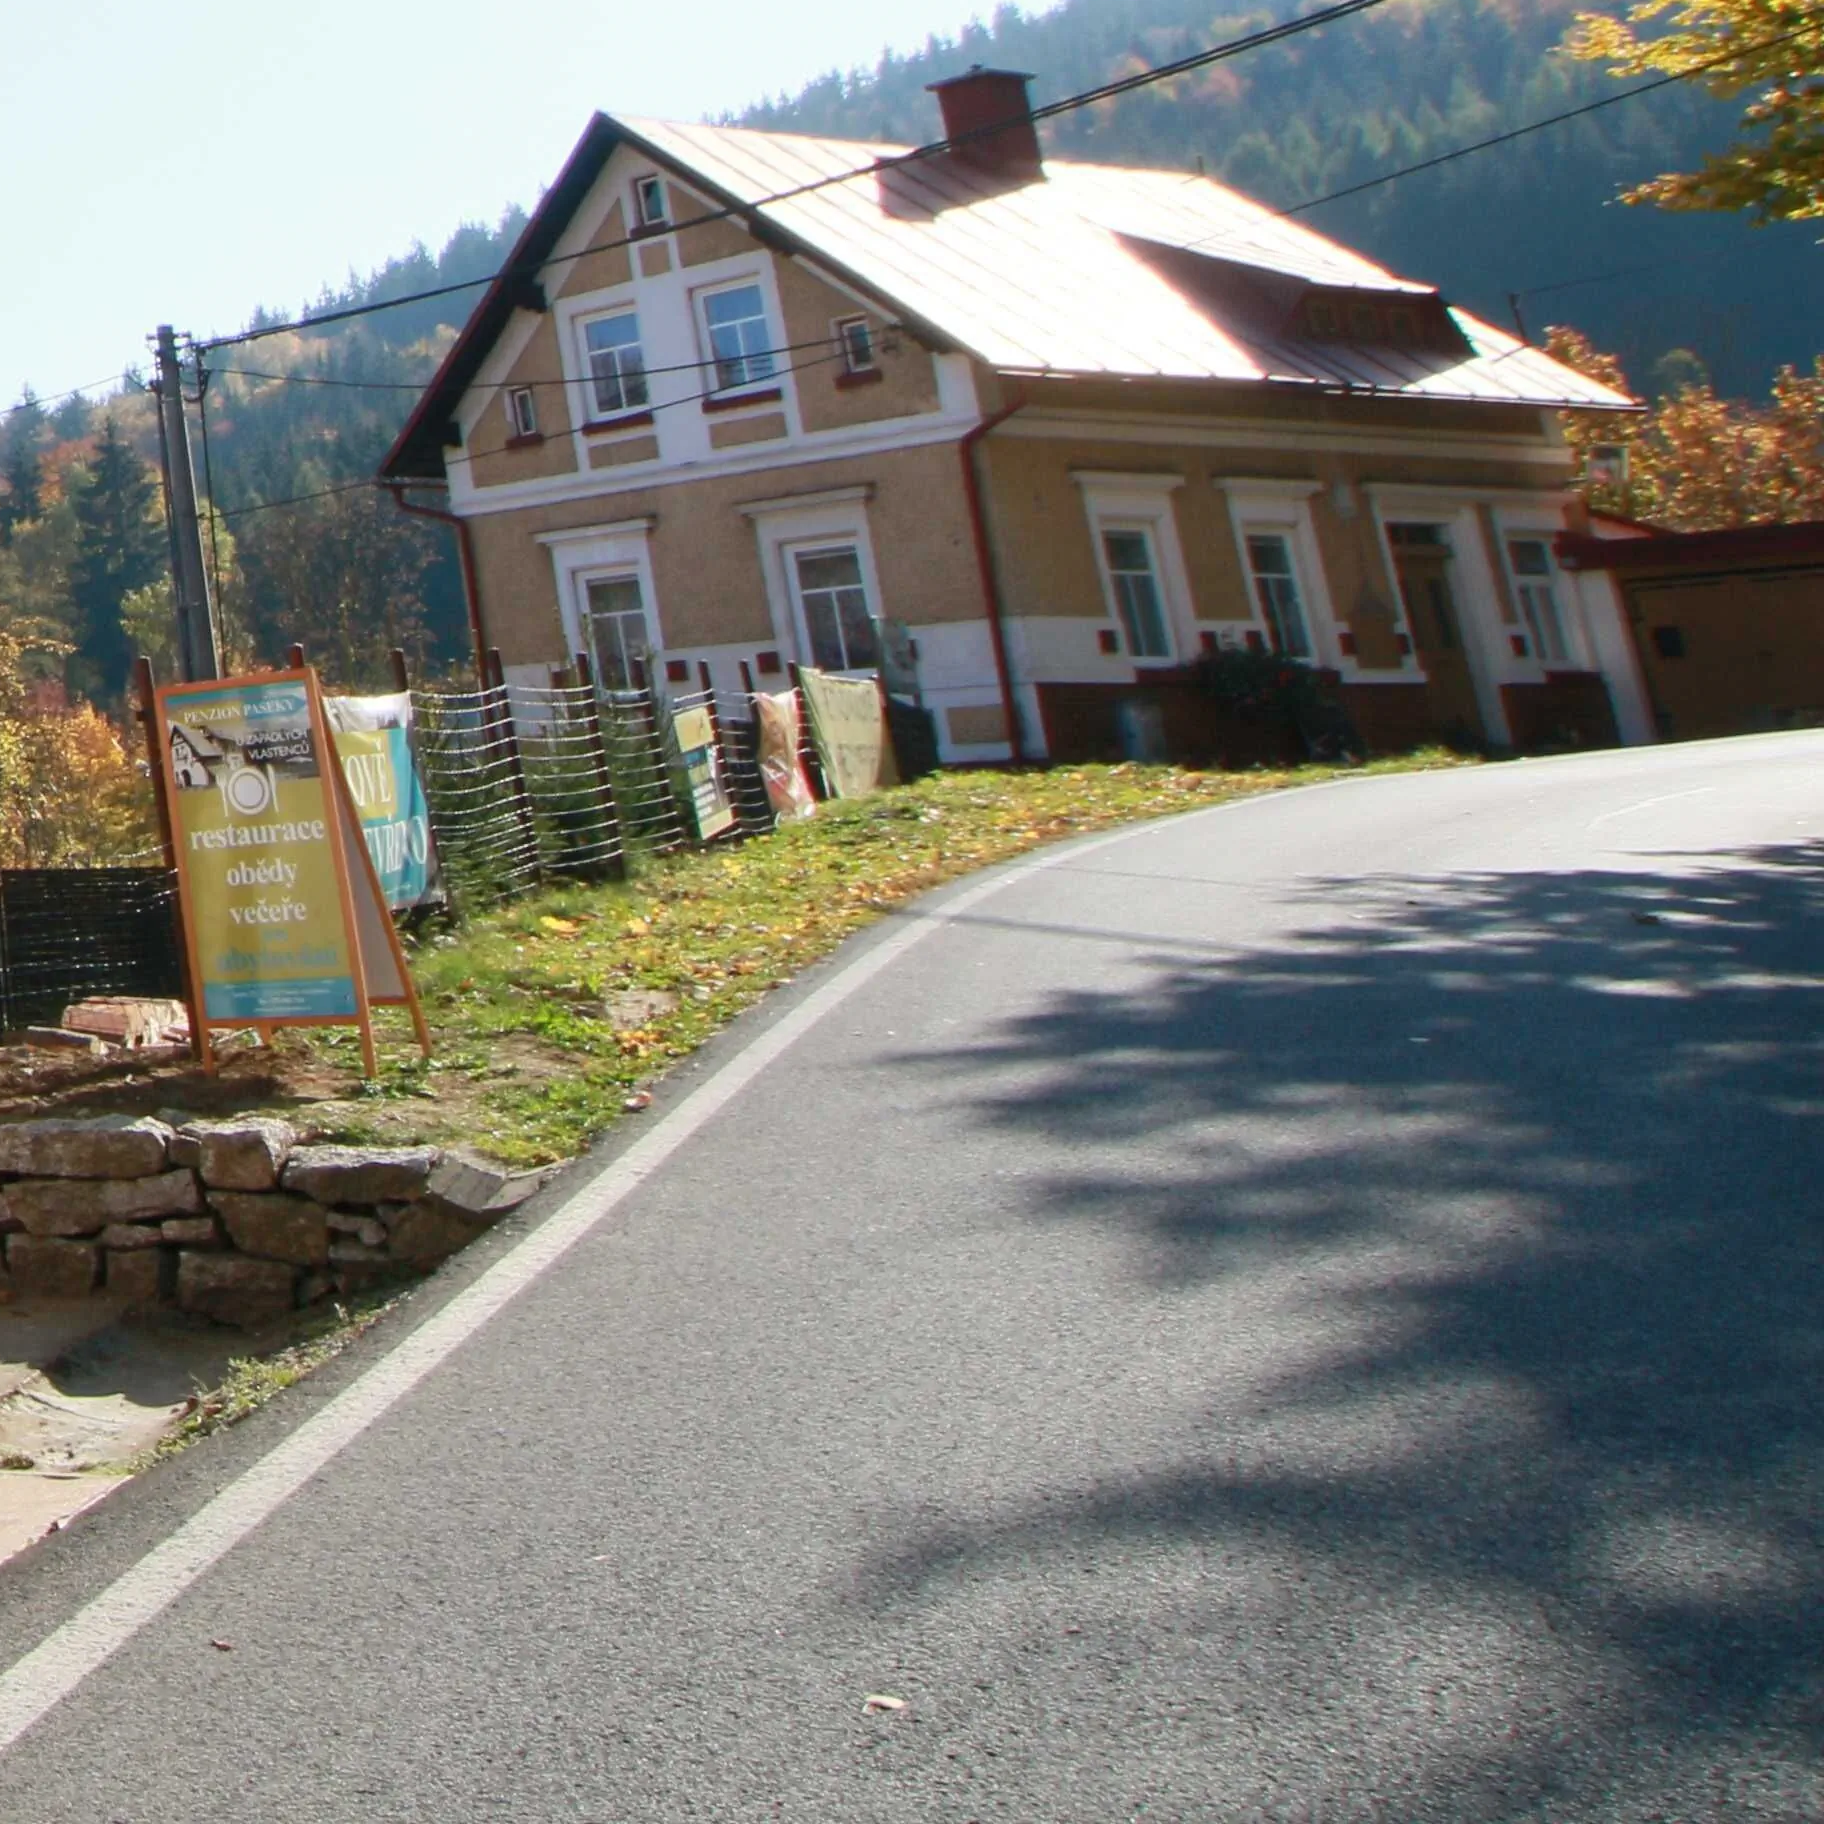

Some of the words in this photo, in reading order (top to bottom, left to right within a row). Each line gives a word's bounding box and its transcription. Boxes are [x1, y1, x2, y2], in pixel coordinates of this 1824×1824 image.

[184, 705, 241, 723] PENZION
[248, 741, 310, 760] VLASTENCŮ
[340, 736, 392, 808] OVĚ
[190, 819, 325, 851] restaurace
[227, 856, 297, 888] obědy
[229, 895, 307, 925] večeře
